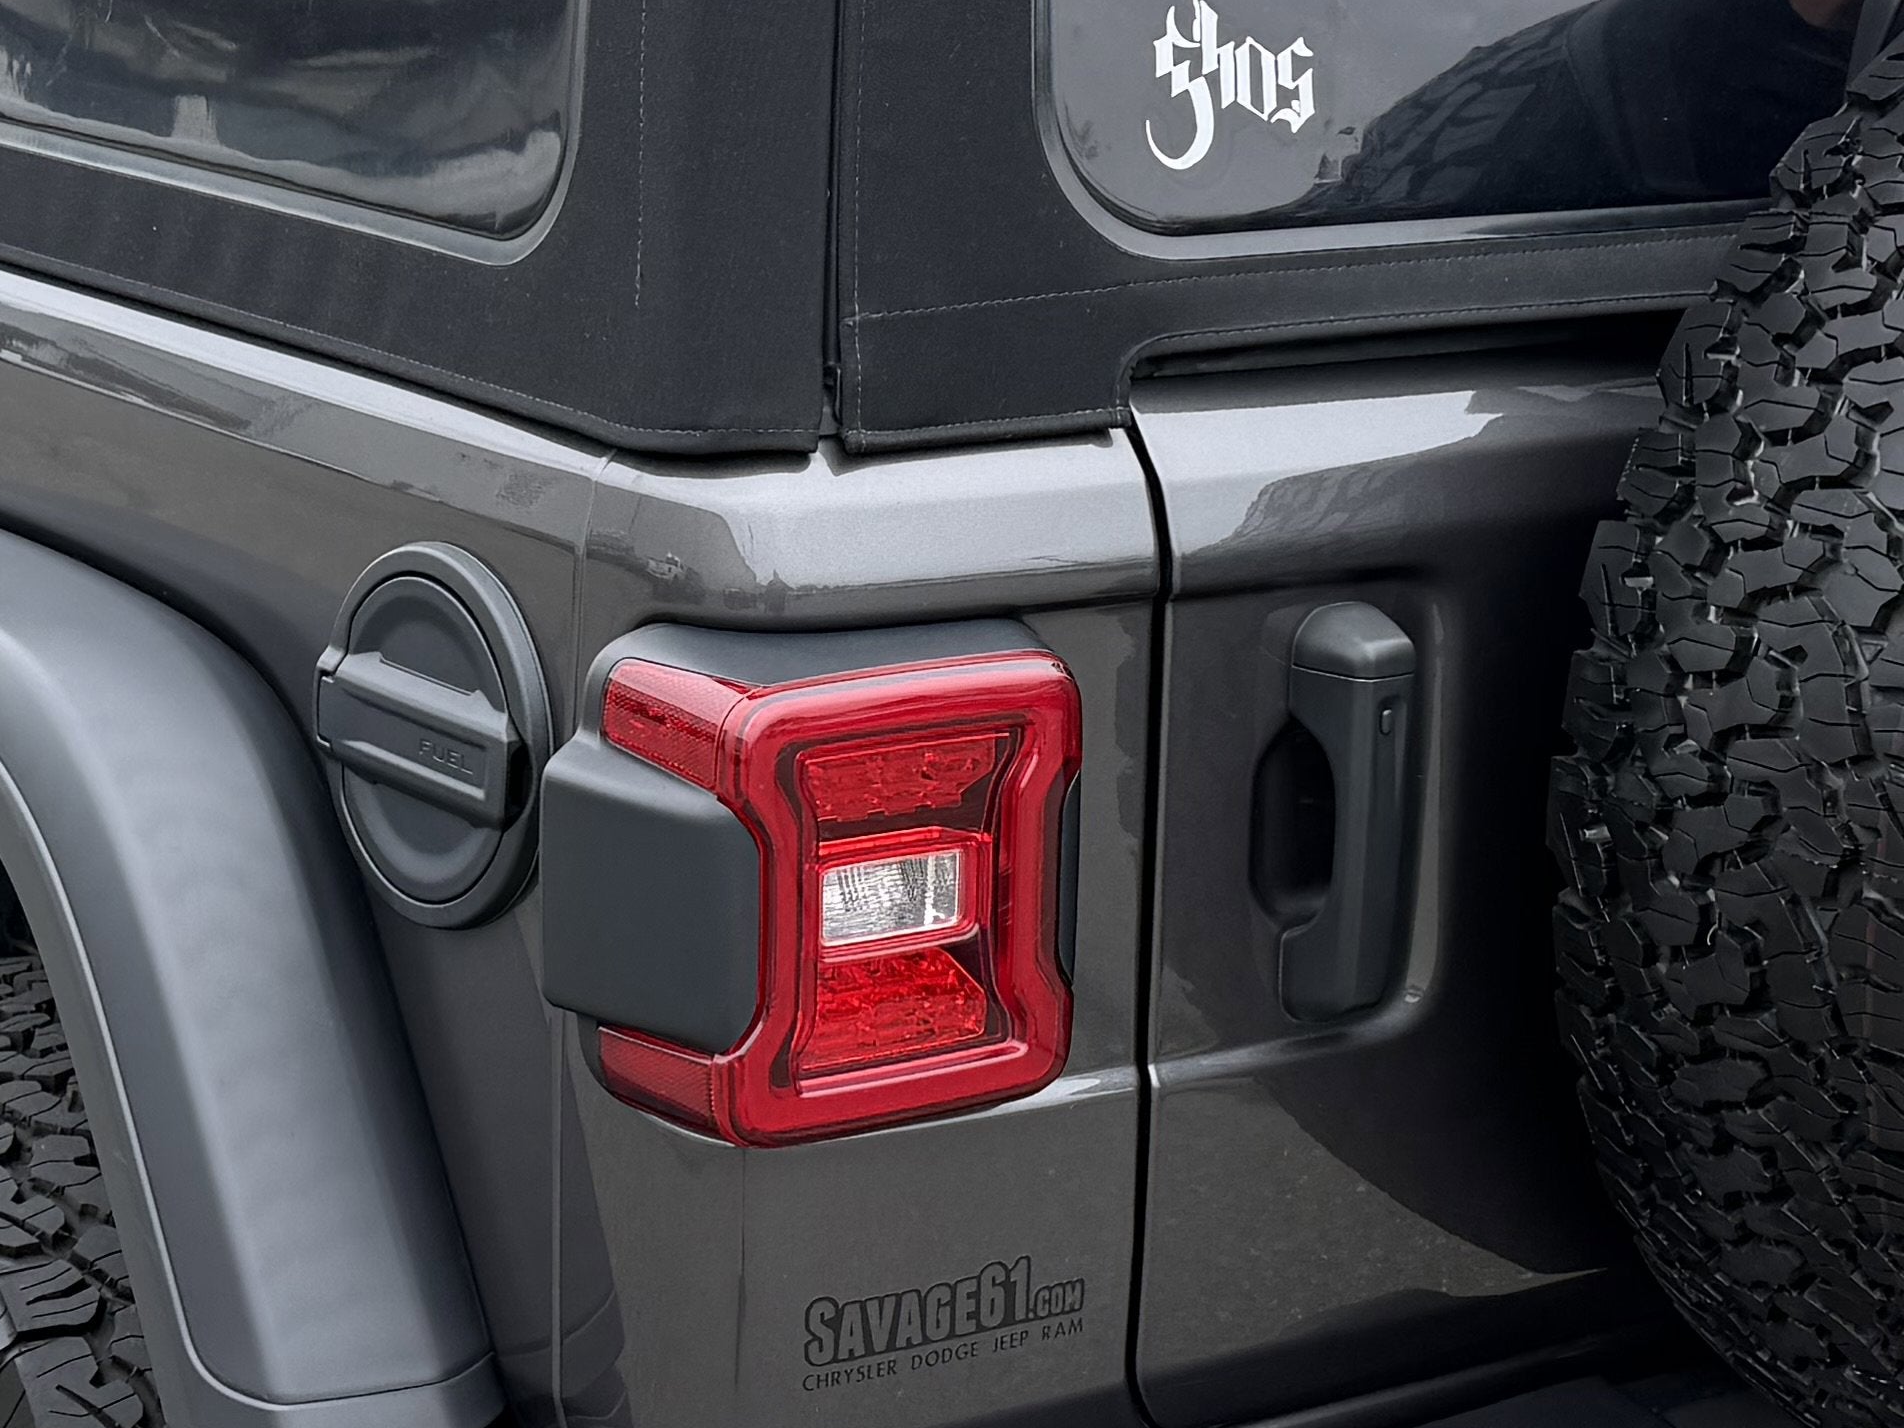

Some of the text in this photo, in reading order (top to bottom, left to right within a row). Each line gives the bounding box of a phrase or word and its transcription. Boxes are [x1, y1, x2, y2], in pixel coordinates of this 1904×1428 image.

[419, 739, 473, 775] FUEL
[802, 1319, 1084, 1392] CHRYSLER DODGE JEEP RAM
